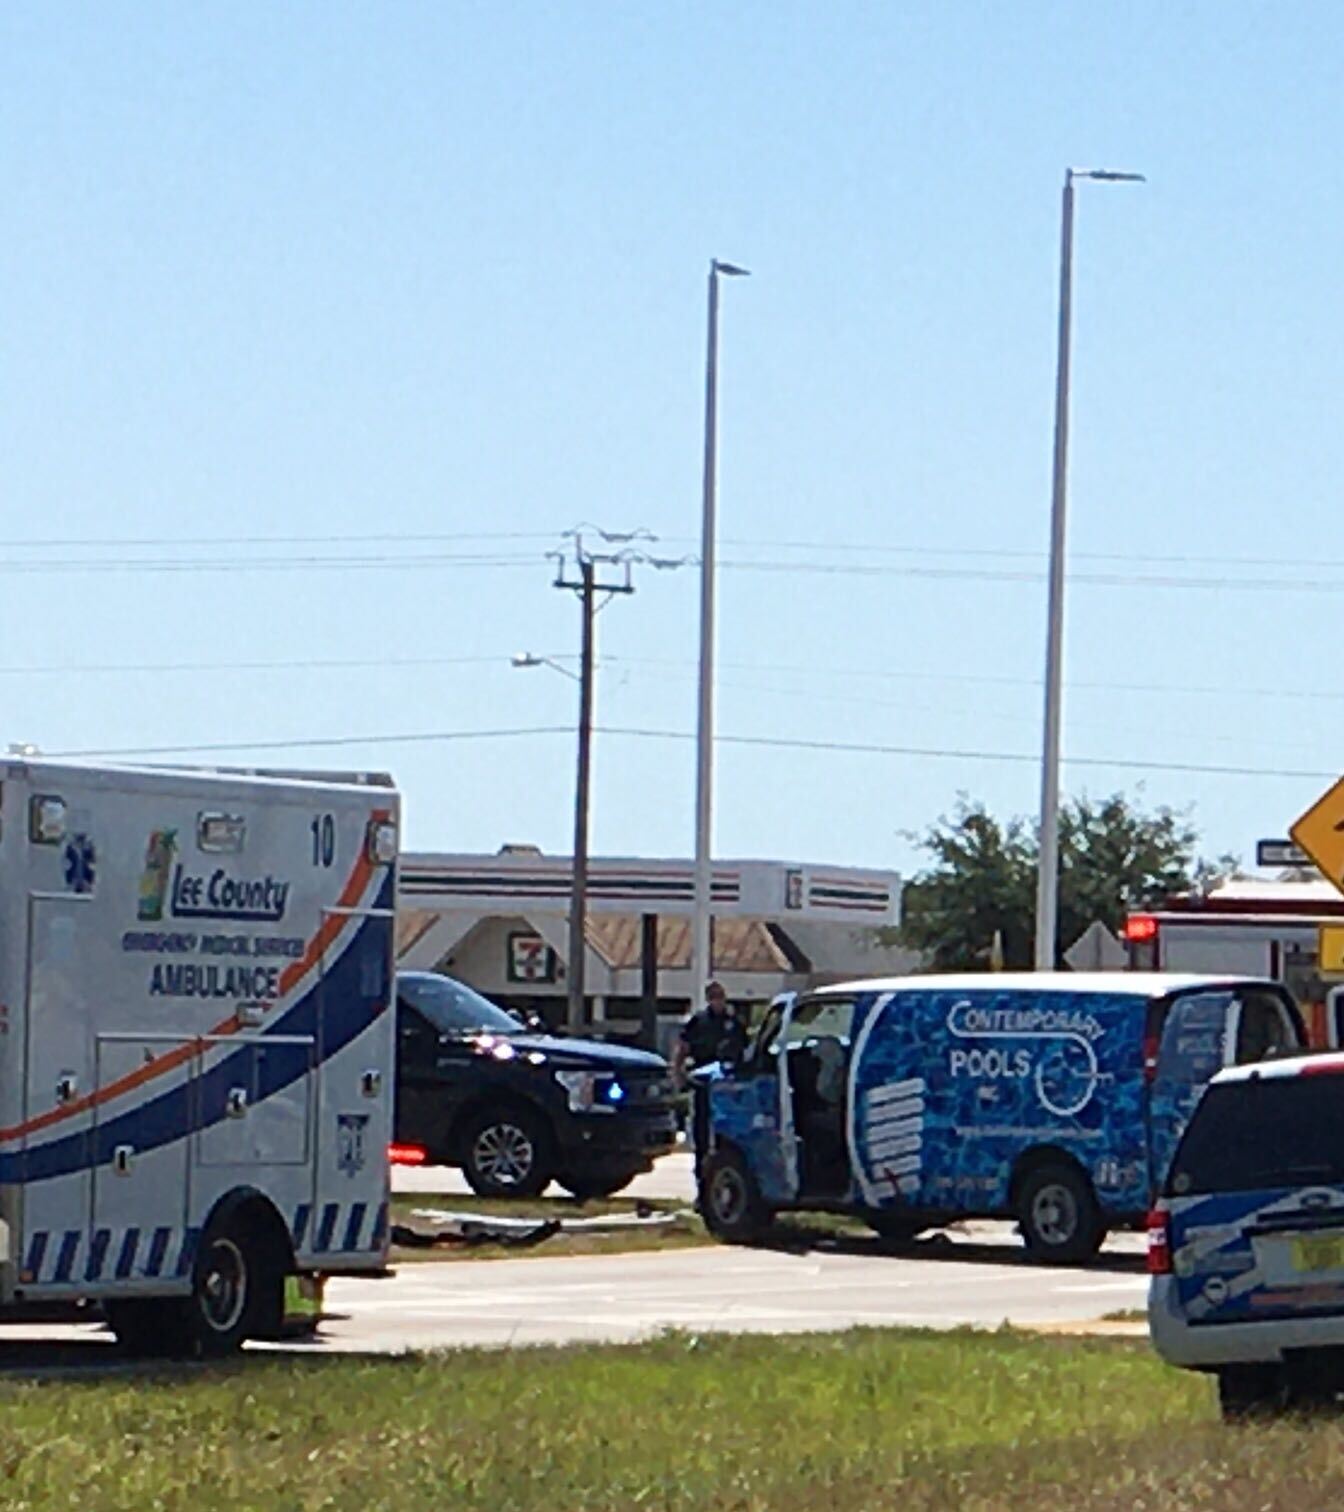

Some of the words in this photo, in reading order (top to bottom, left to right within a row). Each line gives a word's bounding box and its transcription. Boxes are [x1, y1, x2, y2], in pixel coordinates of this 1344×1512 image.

[311, 813, 334, 868] 10
[171, 863, 203, 913] Lee
[206, 868, 289, 919] County
[149, 963, 280, 999] AMBULANCE
[950, 1049, 1032, 1079] POOLS
